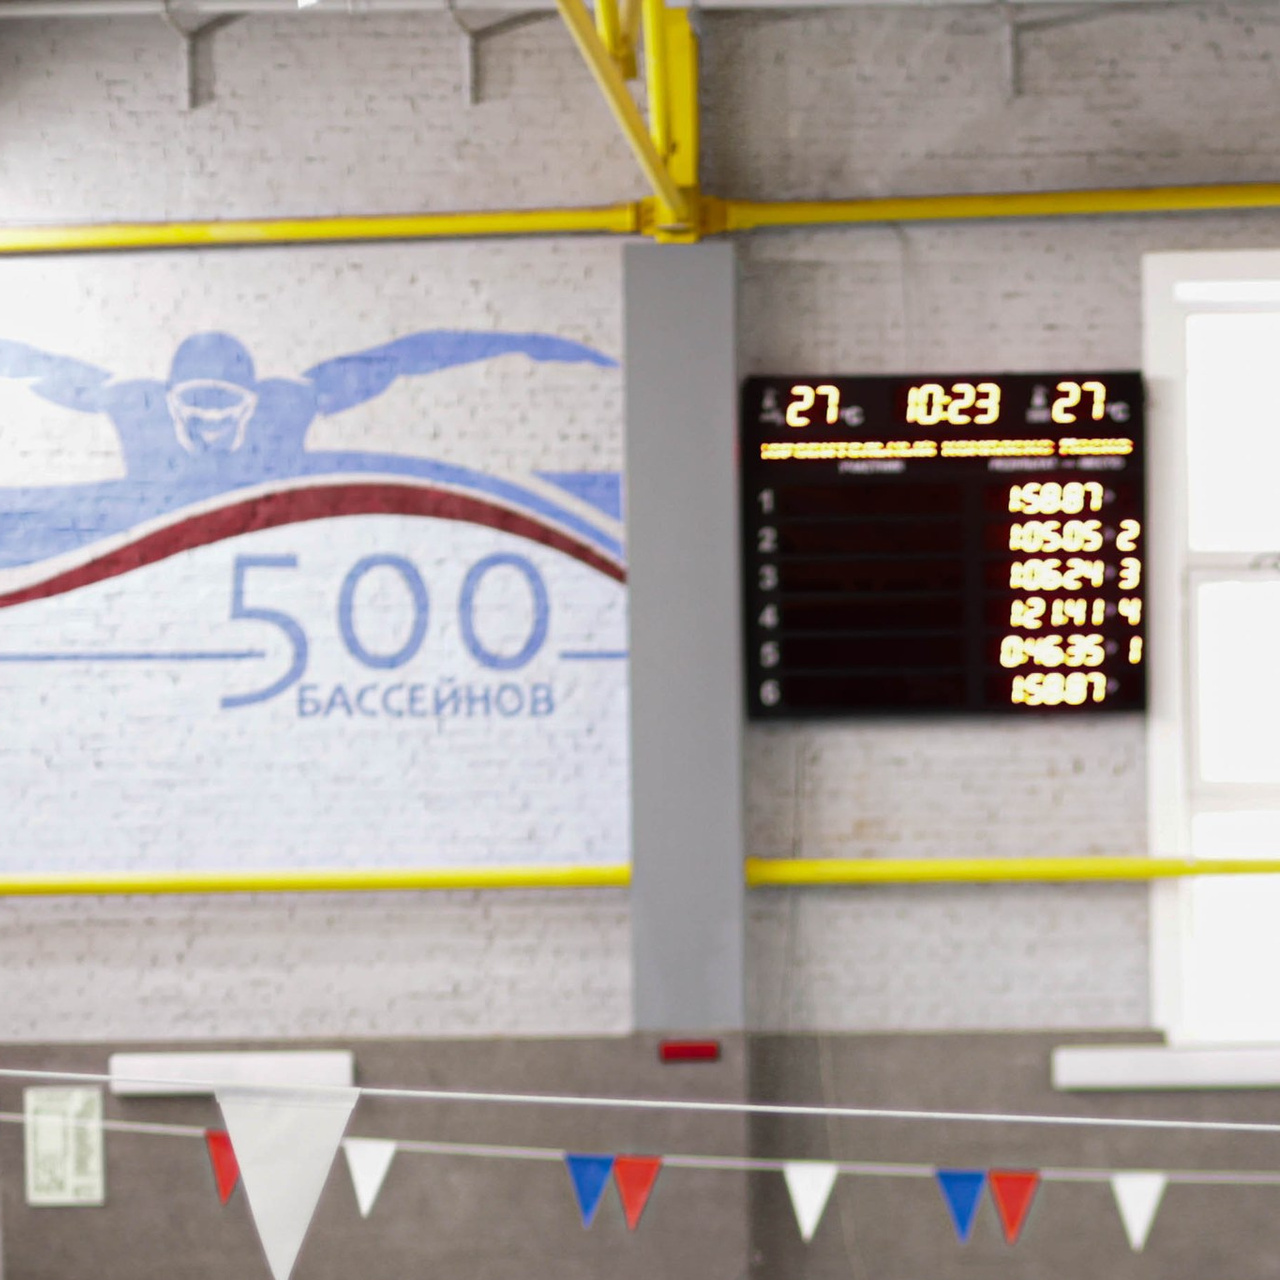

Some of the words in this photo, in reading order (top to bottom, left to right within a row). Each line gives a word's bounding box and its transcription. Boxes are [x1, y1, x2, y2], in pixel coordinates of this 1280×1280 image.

[785, 384, 840, 427] 27
[906, 382, 1001, 425] 10:23
[1051, 381, 1106, 424] 27
[758, 488, 774, 514] 1
[757, 526, 778, 553] 2
[1116, 519, 1140, 551] 2
[758, 564, 778, 591] 3
[1118, 557, 1141, 590] 3
[219, 551, 550, 710] 500
[758, 604, 779, 629] 4
[1118, 597, 1142, 627] 4
[1128, 635, 1143, 664] 1
[298, 677, 556, 718] БАССЕЙНОВ
